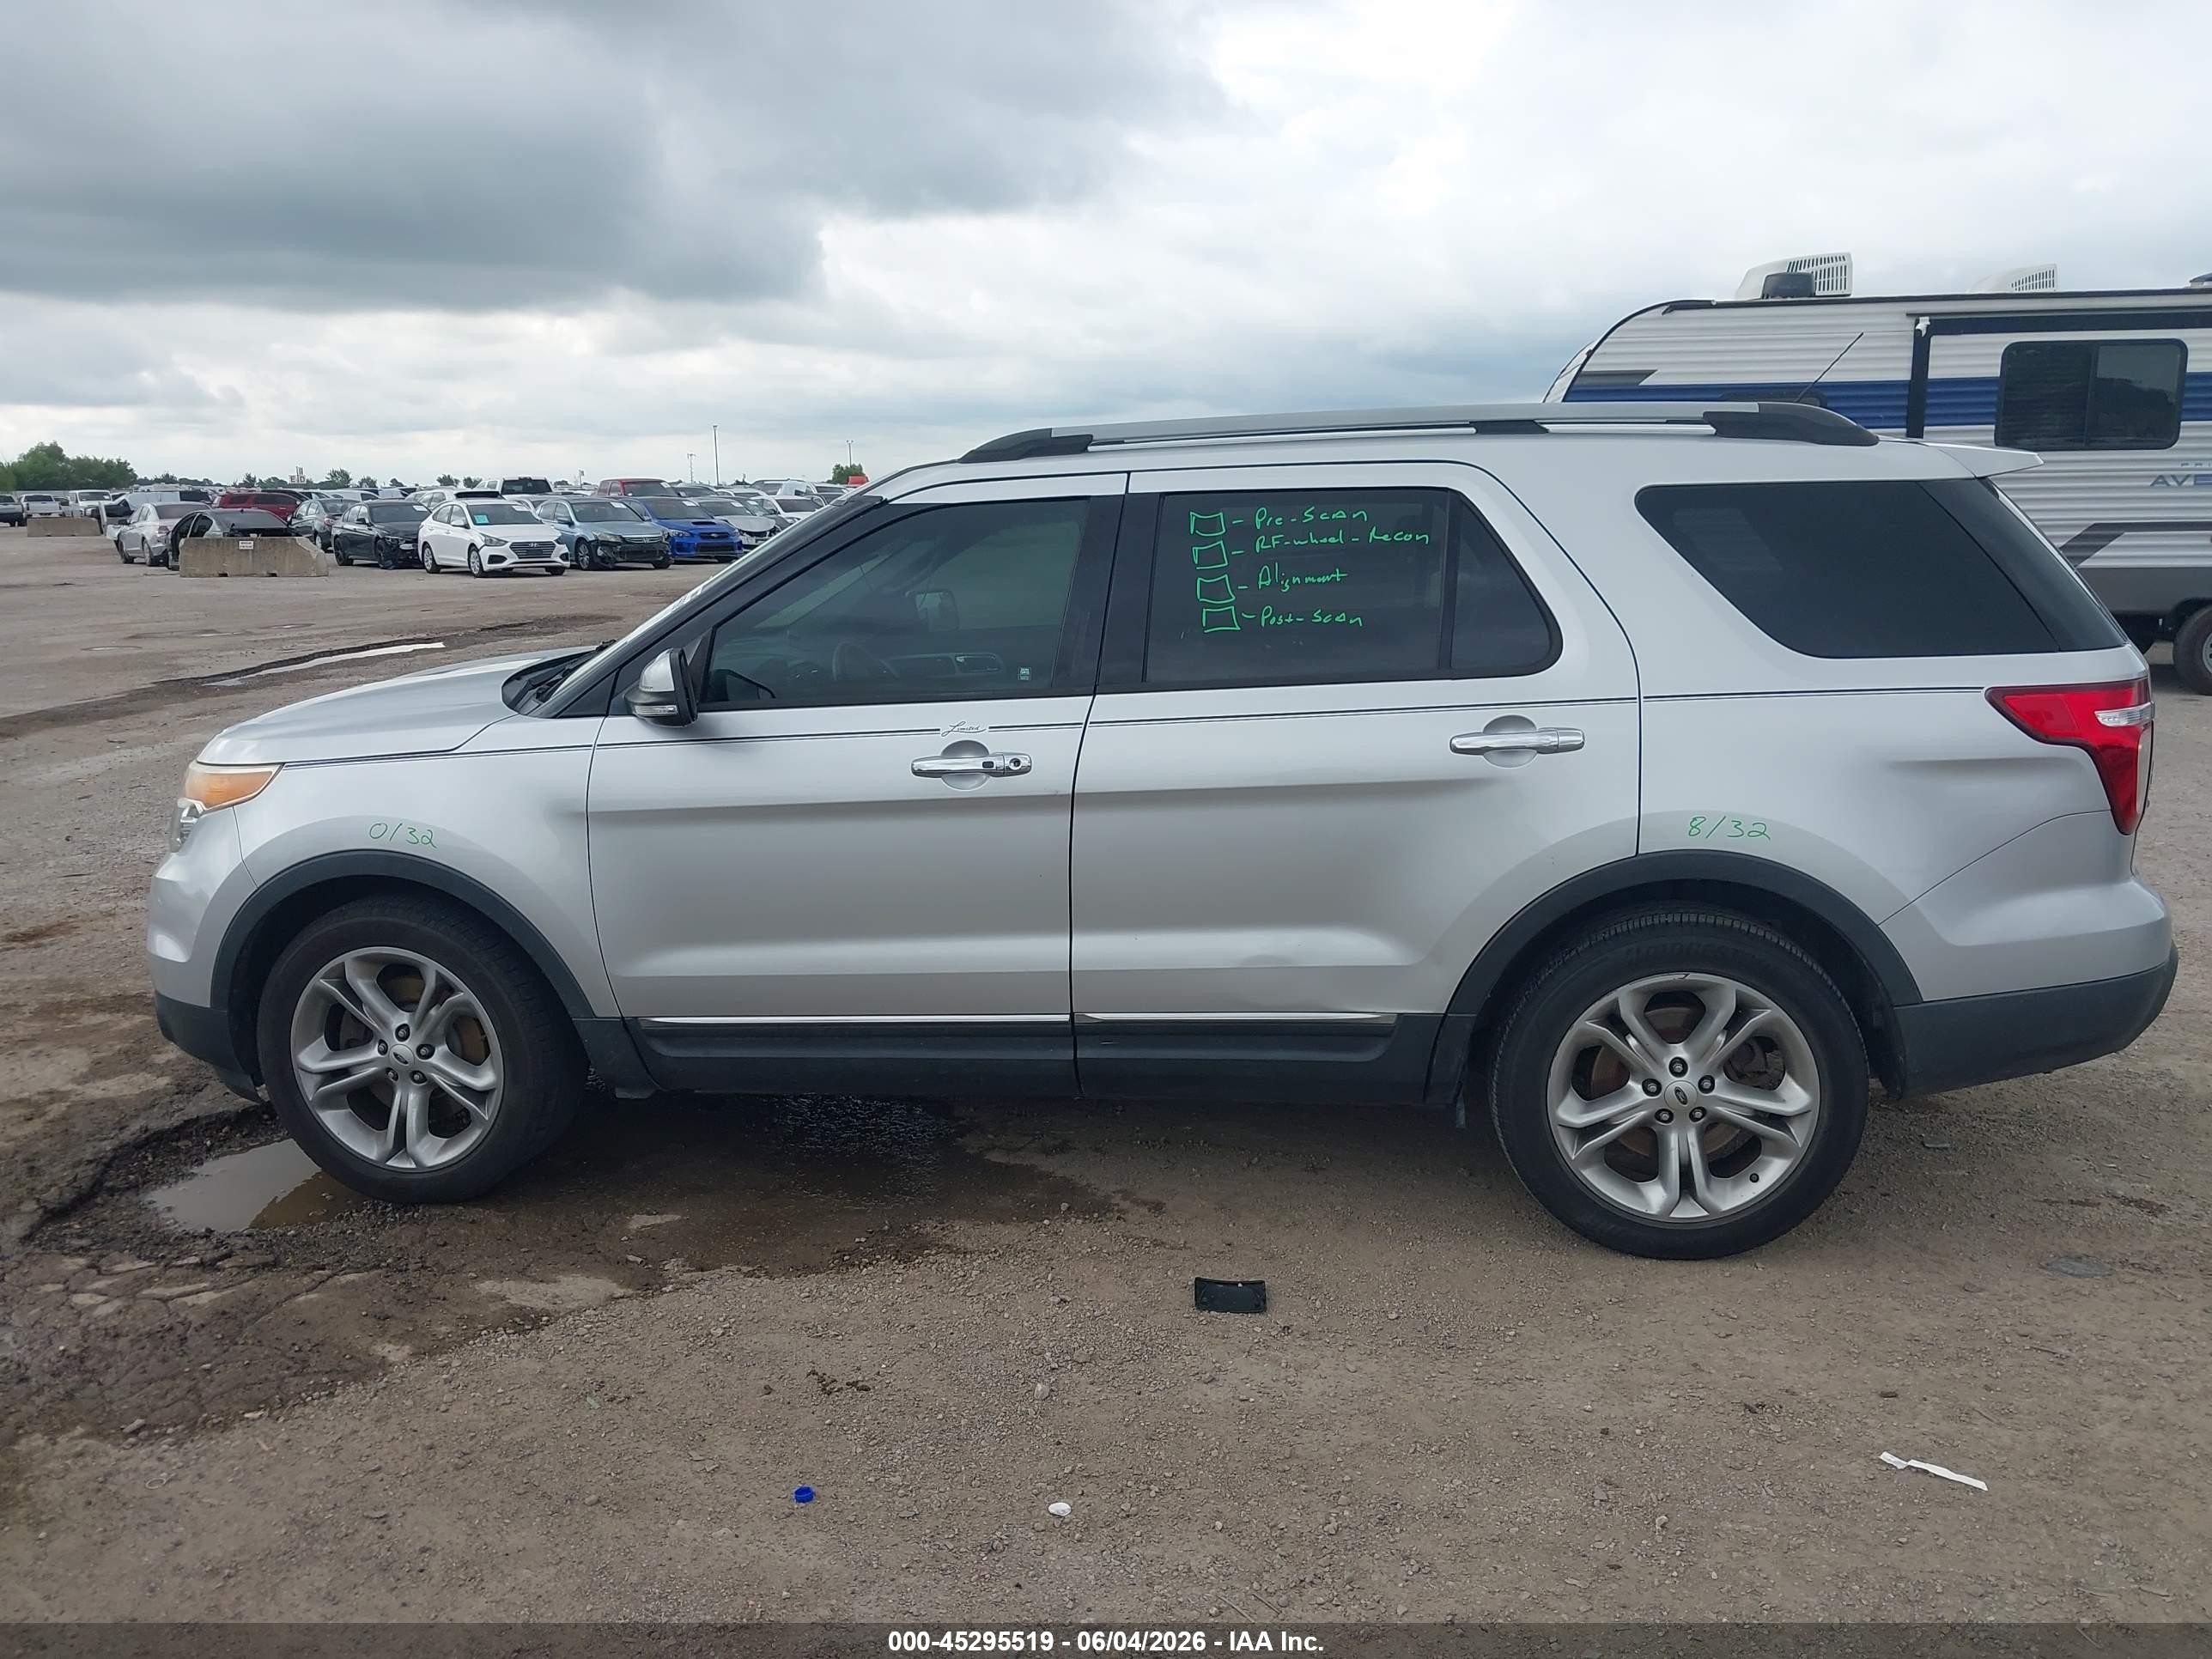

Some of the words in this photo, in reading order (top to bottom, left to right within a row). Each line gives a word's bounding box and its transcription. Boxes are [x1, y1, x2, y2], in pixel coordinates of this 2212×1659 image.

[941, 720, 988, 738] Limited
[369, 823, 438, 849] 0/32
[1688, 816, 1771, 841] 8/32
